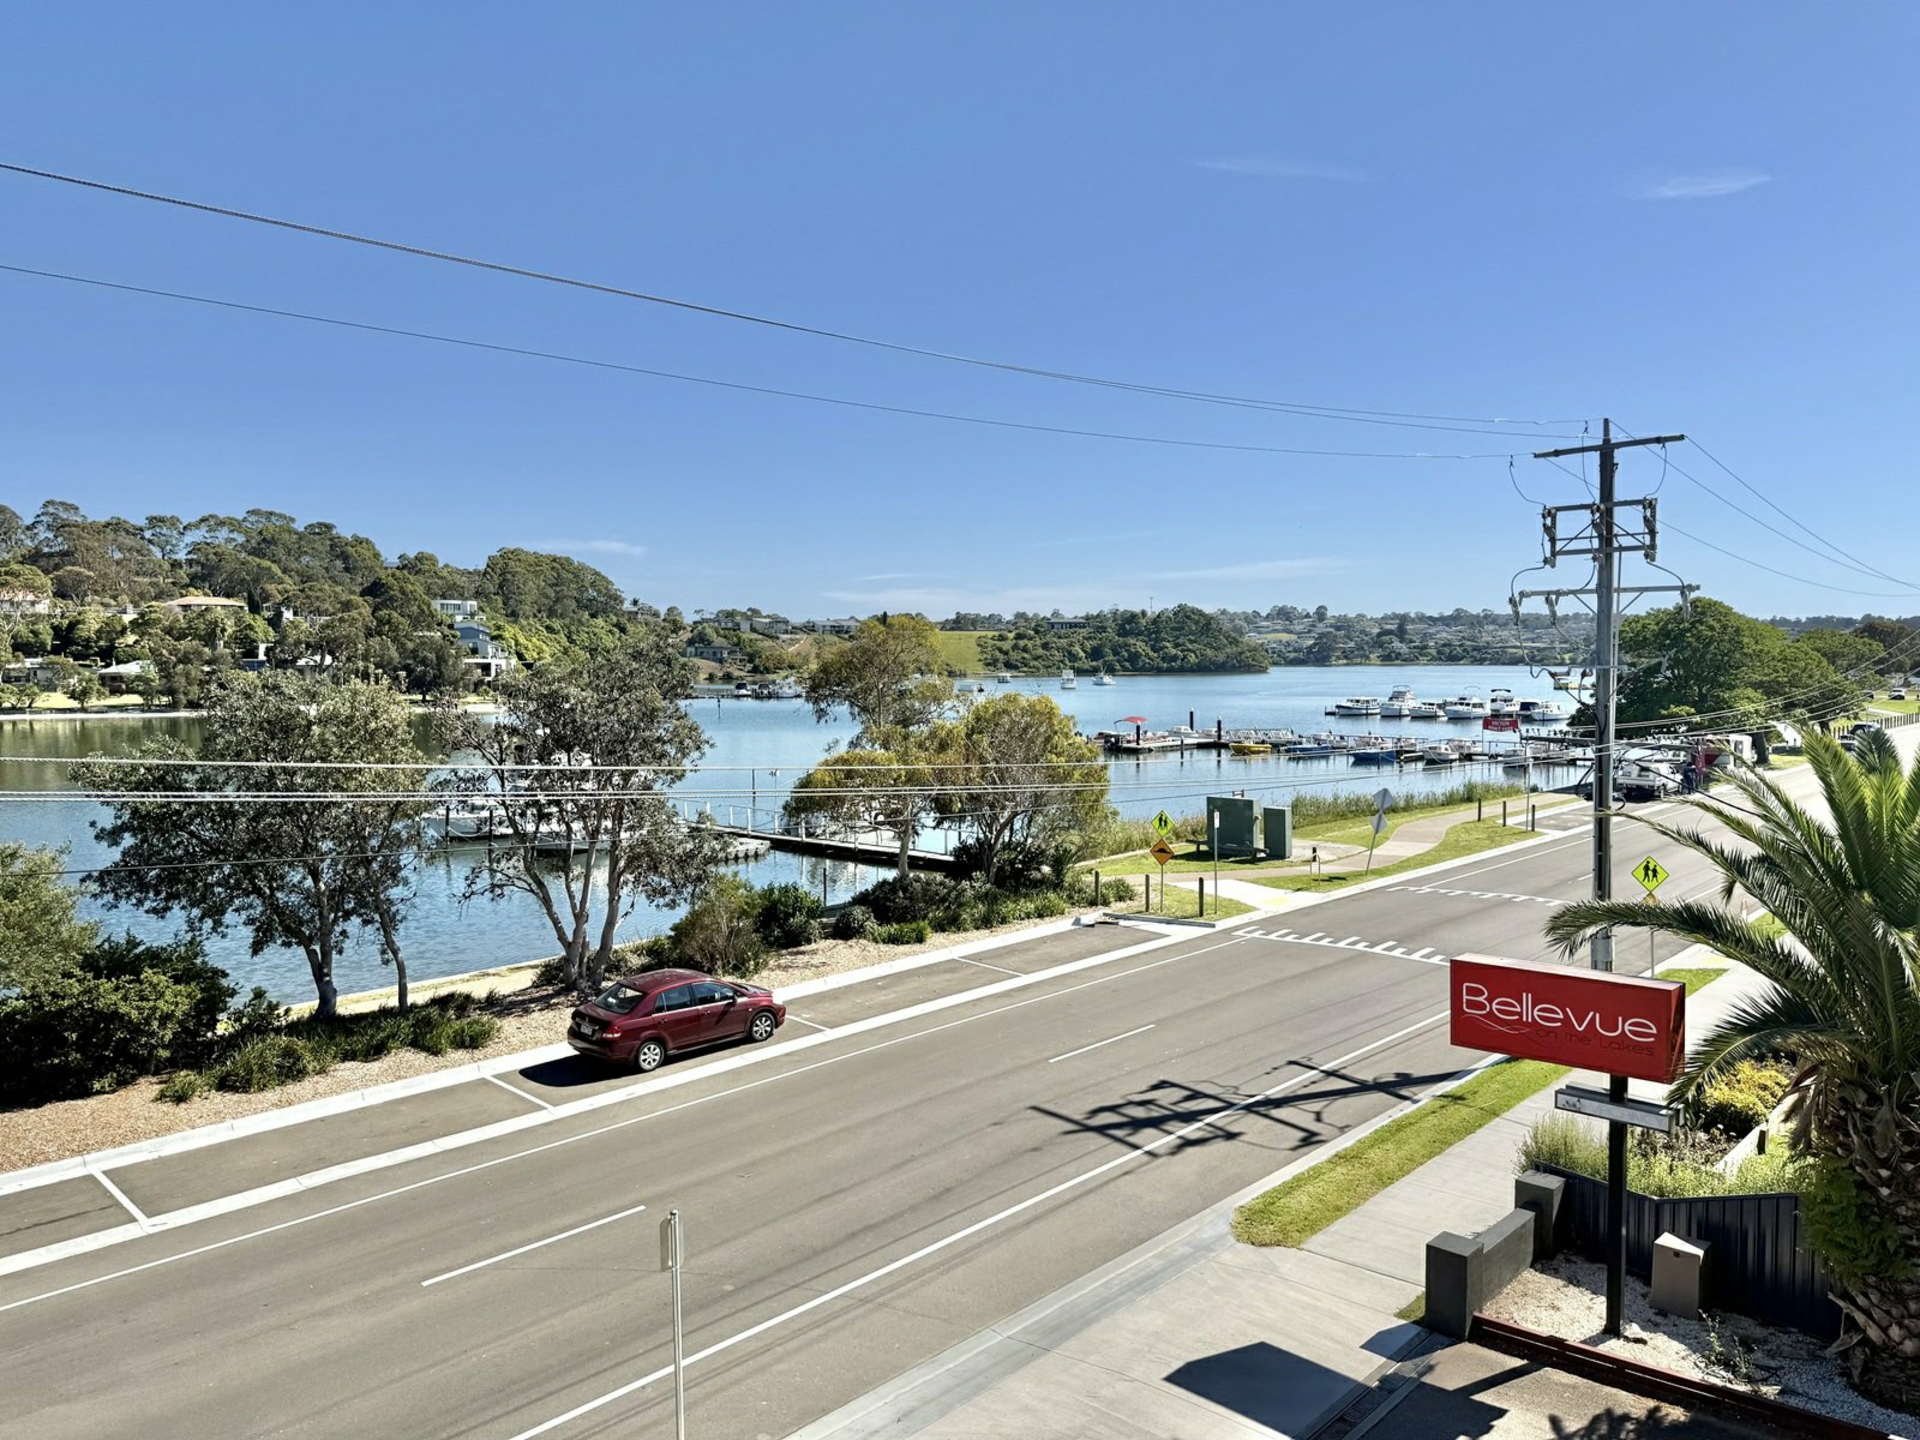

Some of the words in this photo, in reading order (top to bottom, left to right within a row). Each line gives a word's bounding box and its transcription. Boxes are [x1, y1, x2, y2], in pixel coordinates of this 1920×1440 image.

[1462, 982, 1658, 1042] Bellevue
[1535, 1028, 1558, 1040] on
[1565, 1030, 1592, 1046] the
[1600, 1033, 1655, 1057] Lakes
